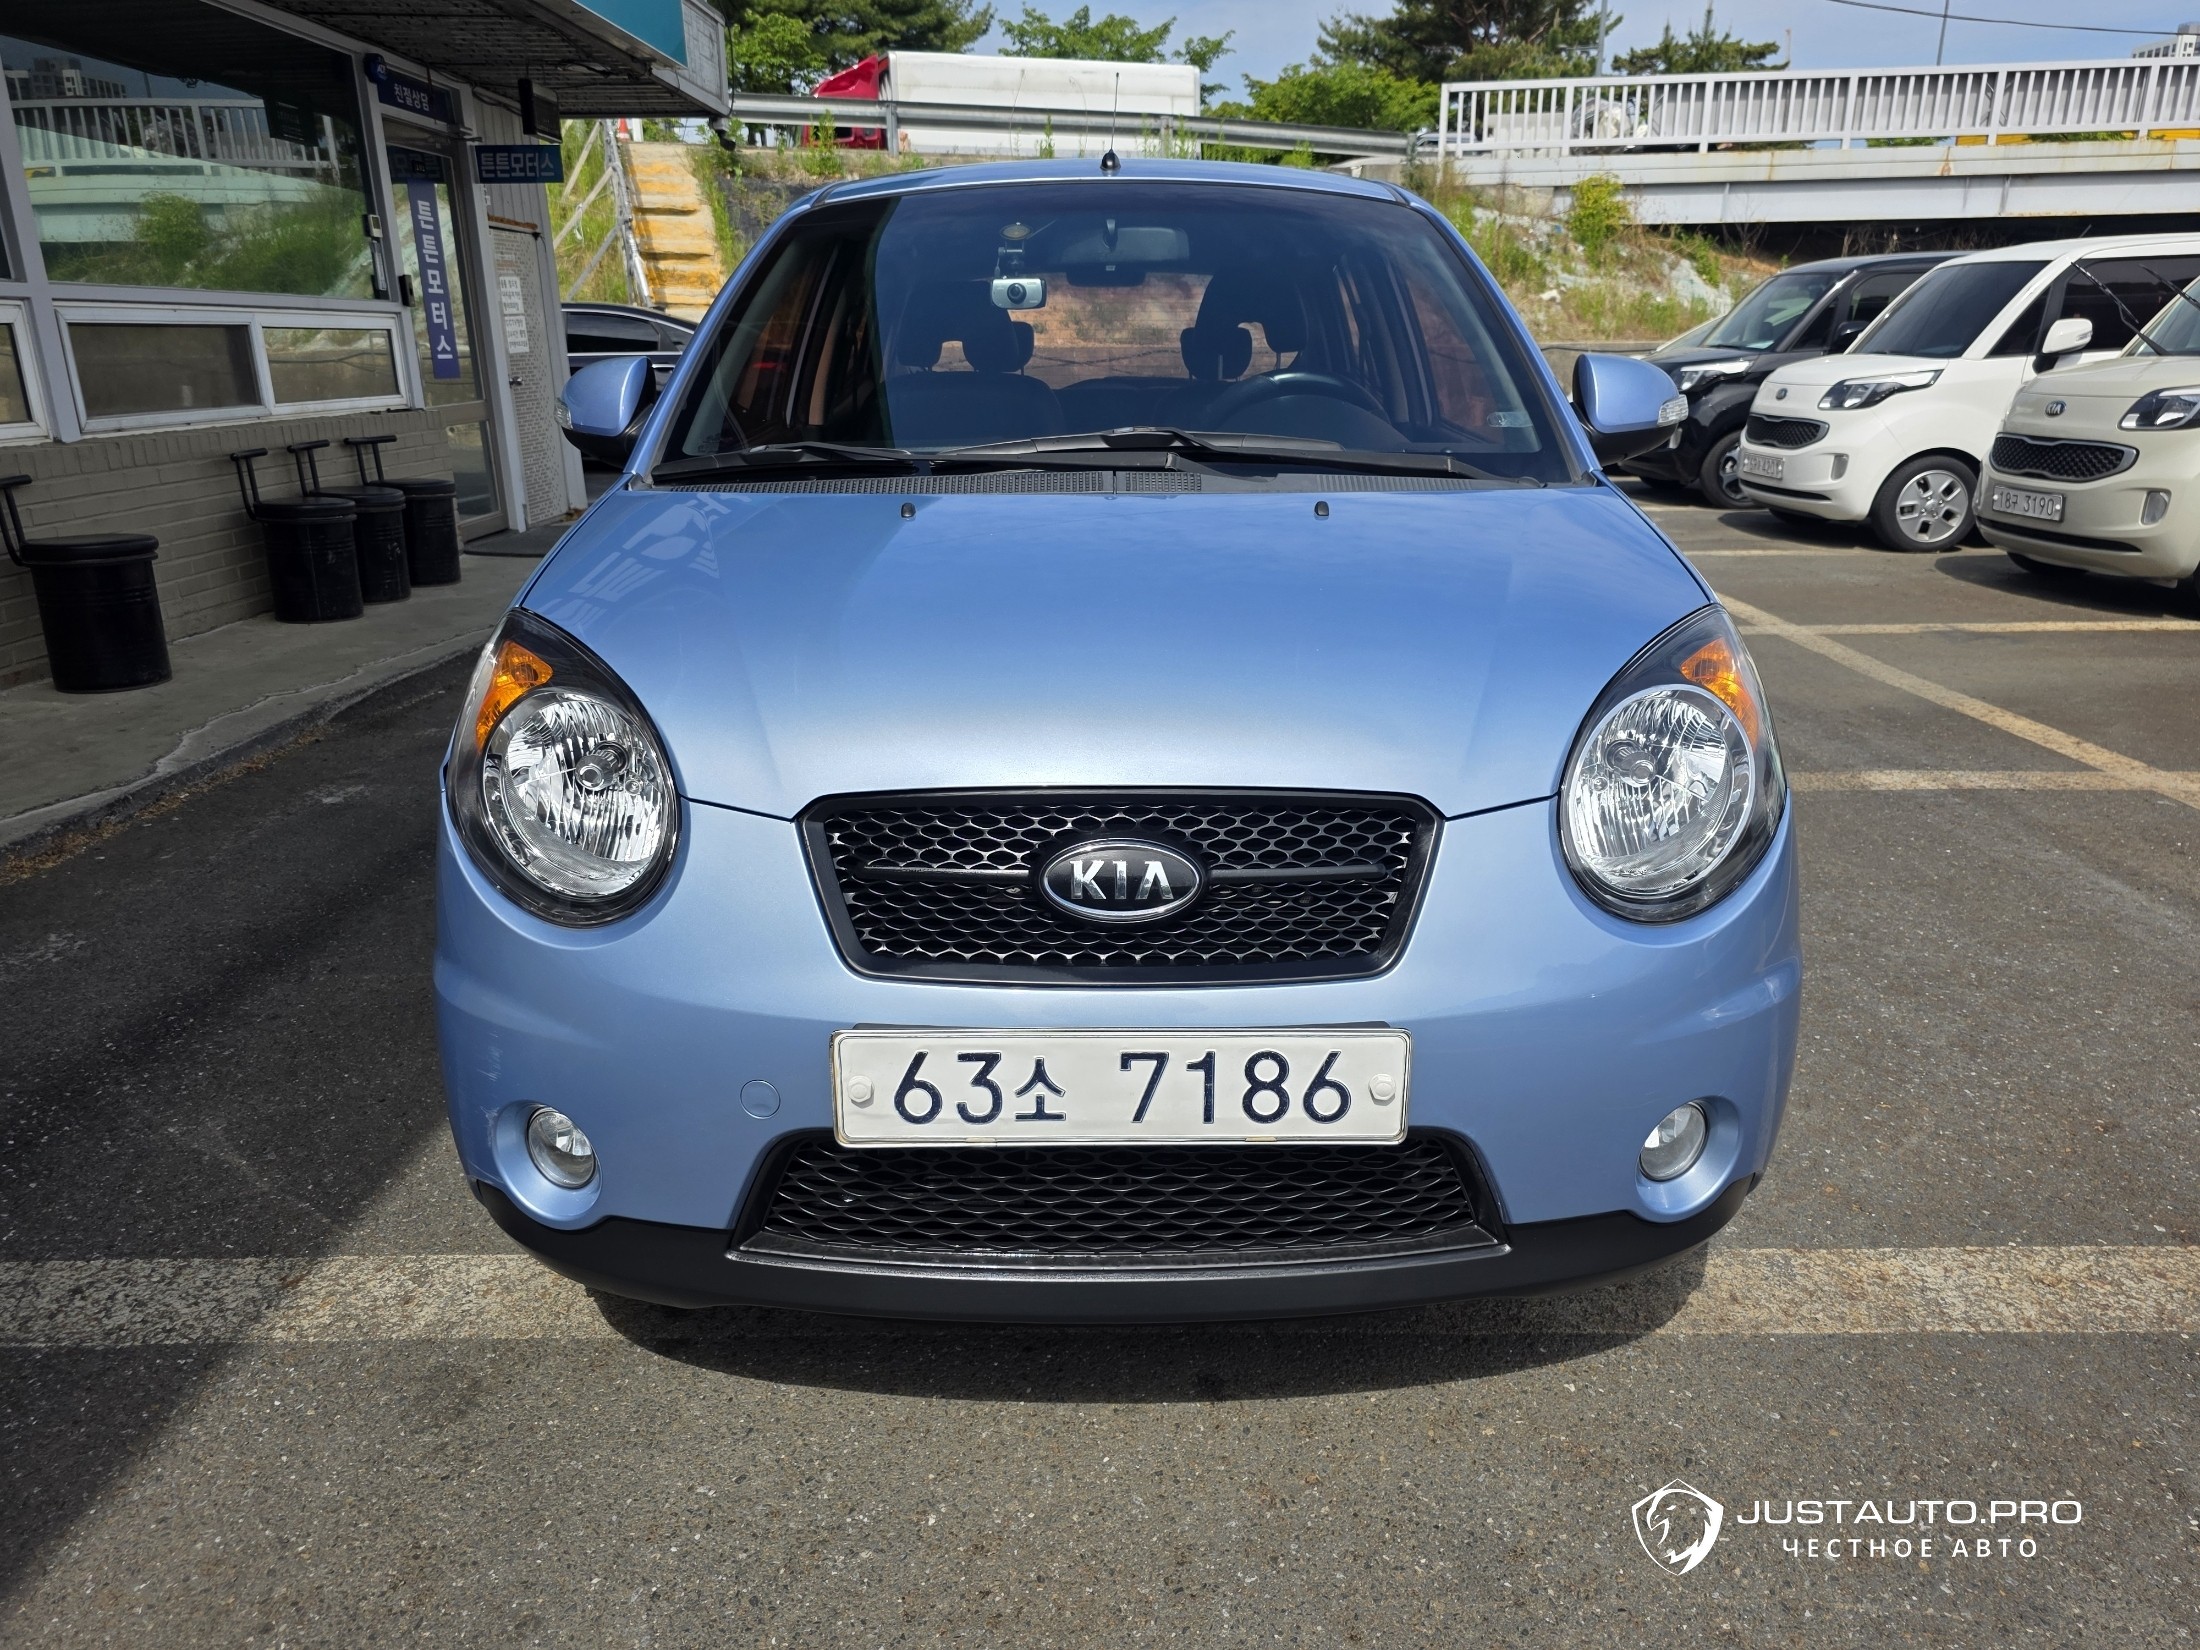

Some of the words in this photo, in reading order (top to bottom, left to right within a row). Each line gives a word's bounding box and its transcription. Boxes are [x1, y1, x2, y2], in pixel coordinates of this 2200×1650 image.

[394, 83, 430, 112] 친절상담
[481, 153, 555, 178] 튼튼모터스
[417, 200, 453, 360] 튼튼모터스
[2046, 403, 2062, 414] KIA
[2023, 495, 2055, 516] 3190
[1069, 859, 1174, 900] KIA
[893, 1050, 1067, 1125] 63소
[1119, 1050, 1353, 1126] 7186
